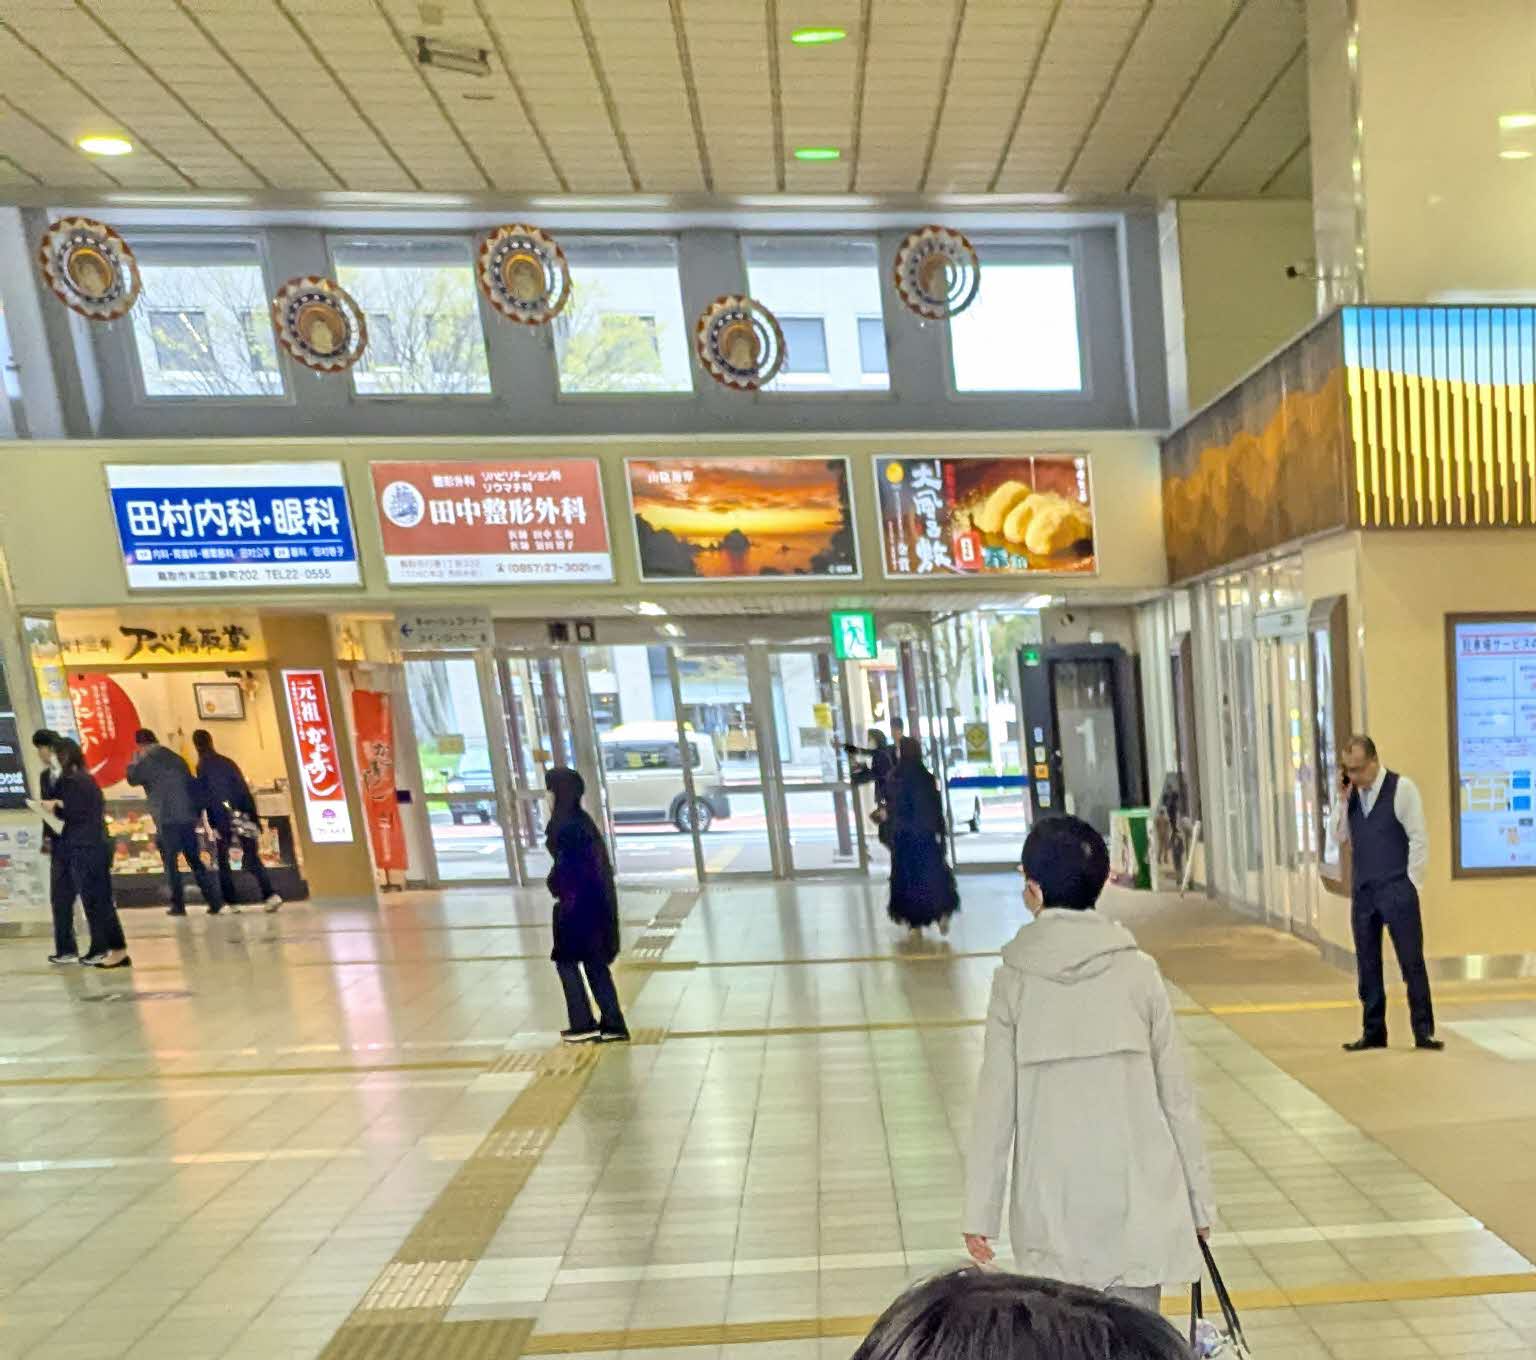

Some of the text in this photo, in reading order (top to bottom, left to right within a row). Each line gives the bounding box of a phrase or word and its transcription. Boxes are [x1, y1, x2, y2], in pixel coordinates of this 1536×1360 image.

[431, 474, 476, 488] 整形外科
[482, 483, 533, 493] リウマチ科
[125, 497, 340, 538] 田村内科・眼科
[429, 496, 587, 526] 田中整形外科
[119, 624, 250, 661] アベ鳥取堂
